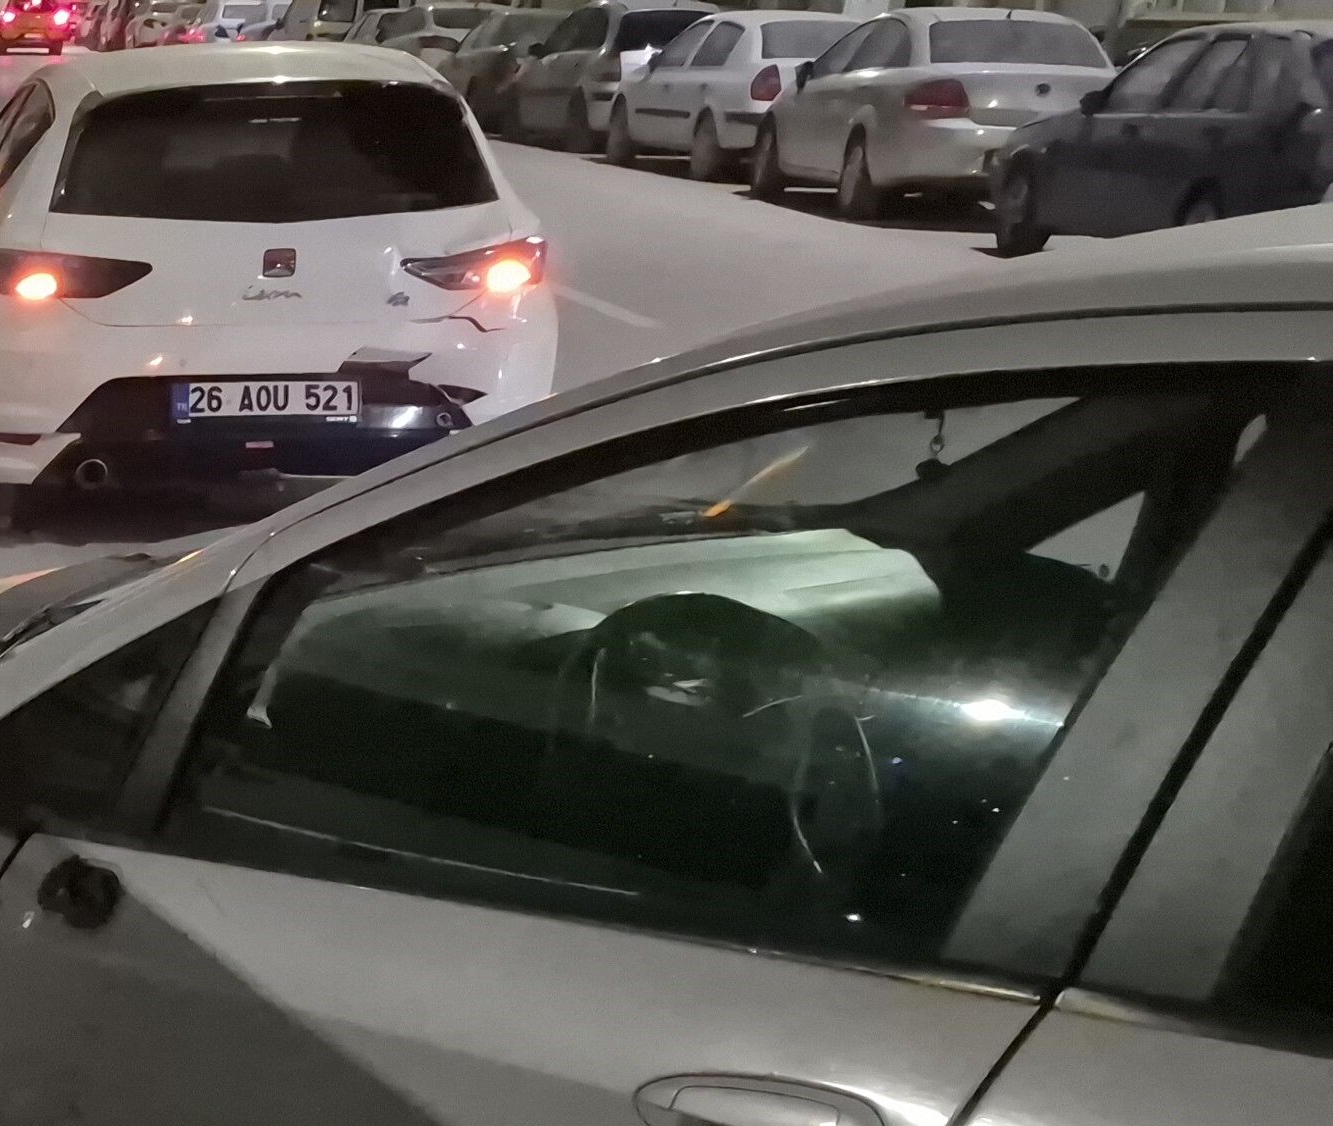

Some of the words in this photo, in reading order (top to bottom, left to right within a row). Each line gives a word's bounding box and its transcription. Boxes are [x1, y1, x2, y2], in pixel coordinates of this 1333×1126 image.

[190, 385, 223, 413] 26
[239, 384, 290, 412] AOU
[304, 383, 354, 411] 521
